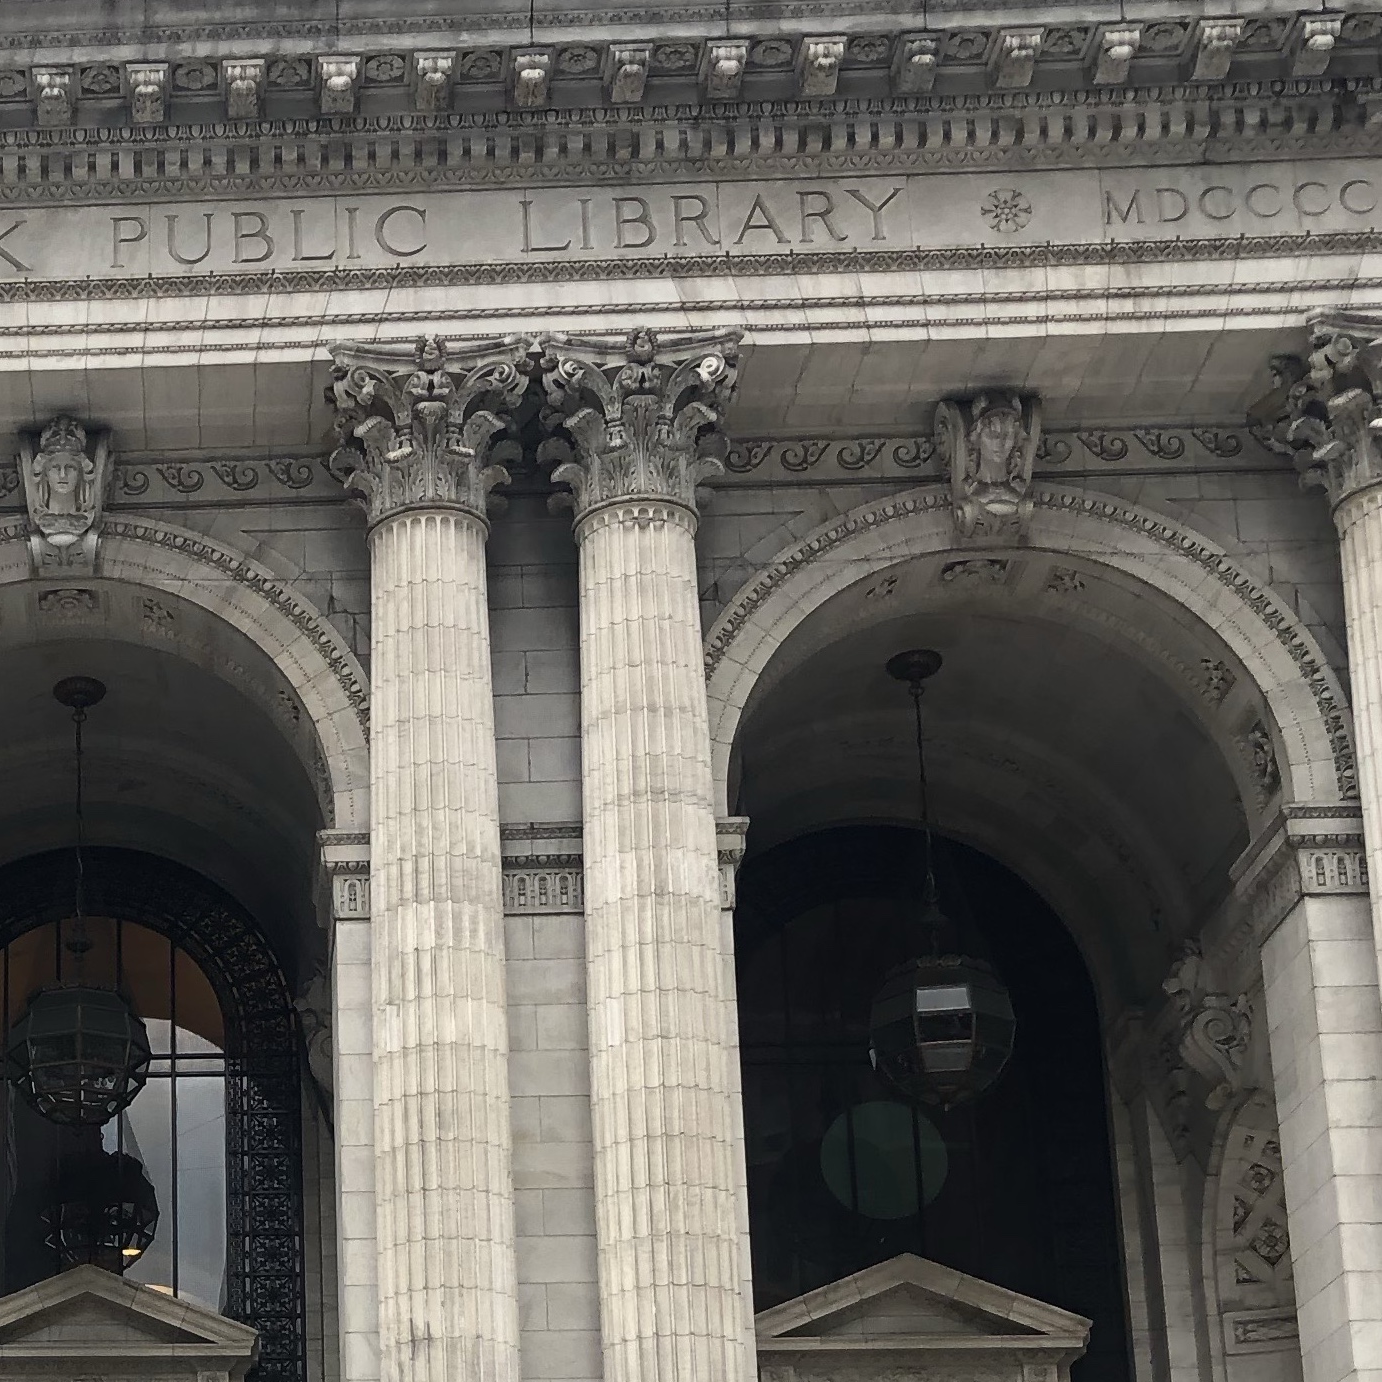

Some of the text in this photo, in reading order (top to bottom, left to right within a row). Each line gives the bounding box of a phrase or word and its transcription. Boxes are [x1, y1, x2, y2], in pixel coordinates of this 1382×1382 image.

[110, 205, 428, 269] PUBLIC
[518, 187, 905, 253] LIBRARY
[1105, 180, 1378, 226] MDCCCC
